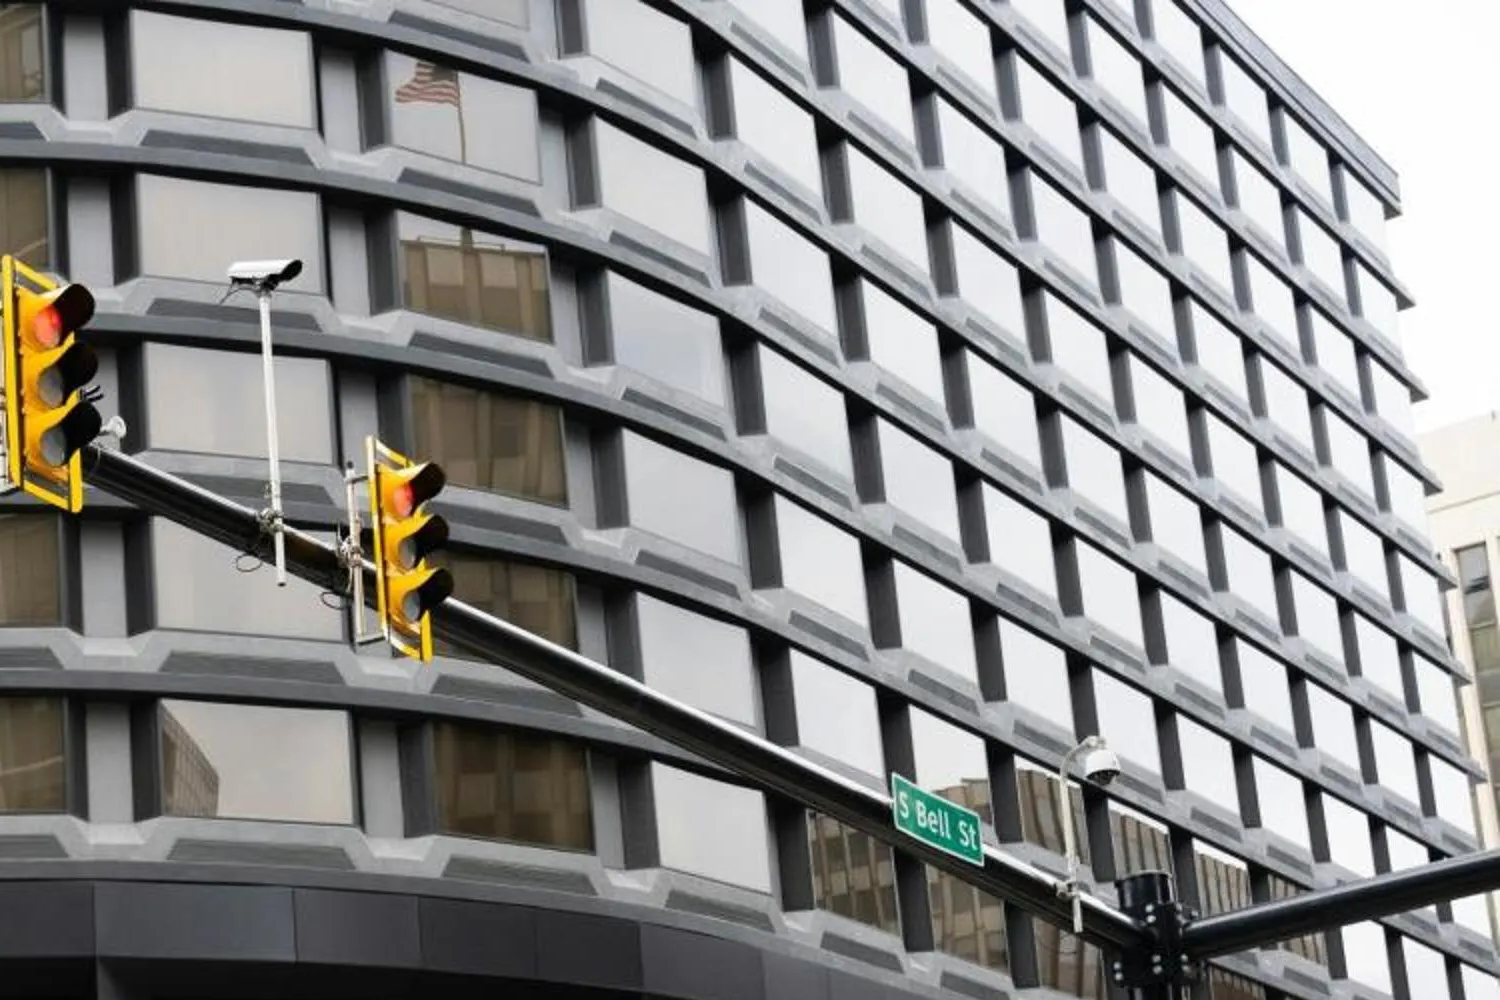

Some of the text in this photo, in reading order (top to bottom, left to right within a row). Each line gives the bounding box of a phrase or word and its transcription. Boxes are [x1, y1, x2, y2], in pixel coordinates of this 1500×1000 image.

[898, 791, 977, 850] S Bell St
